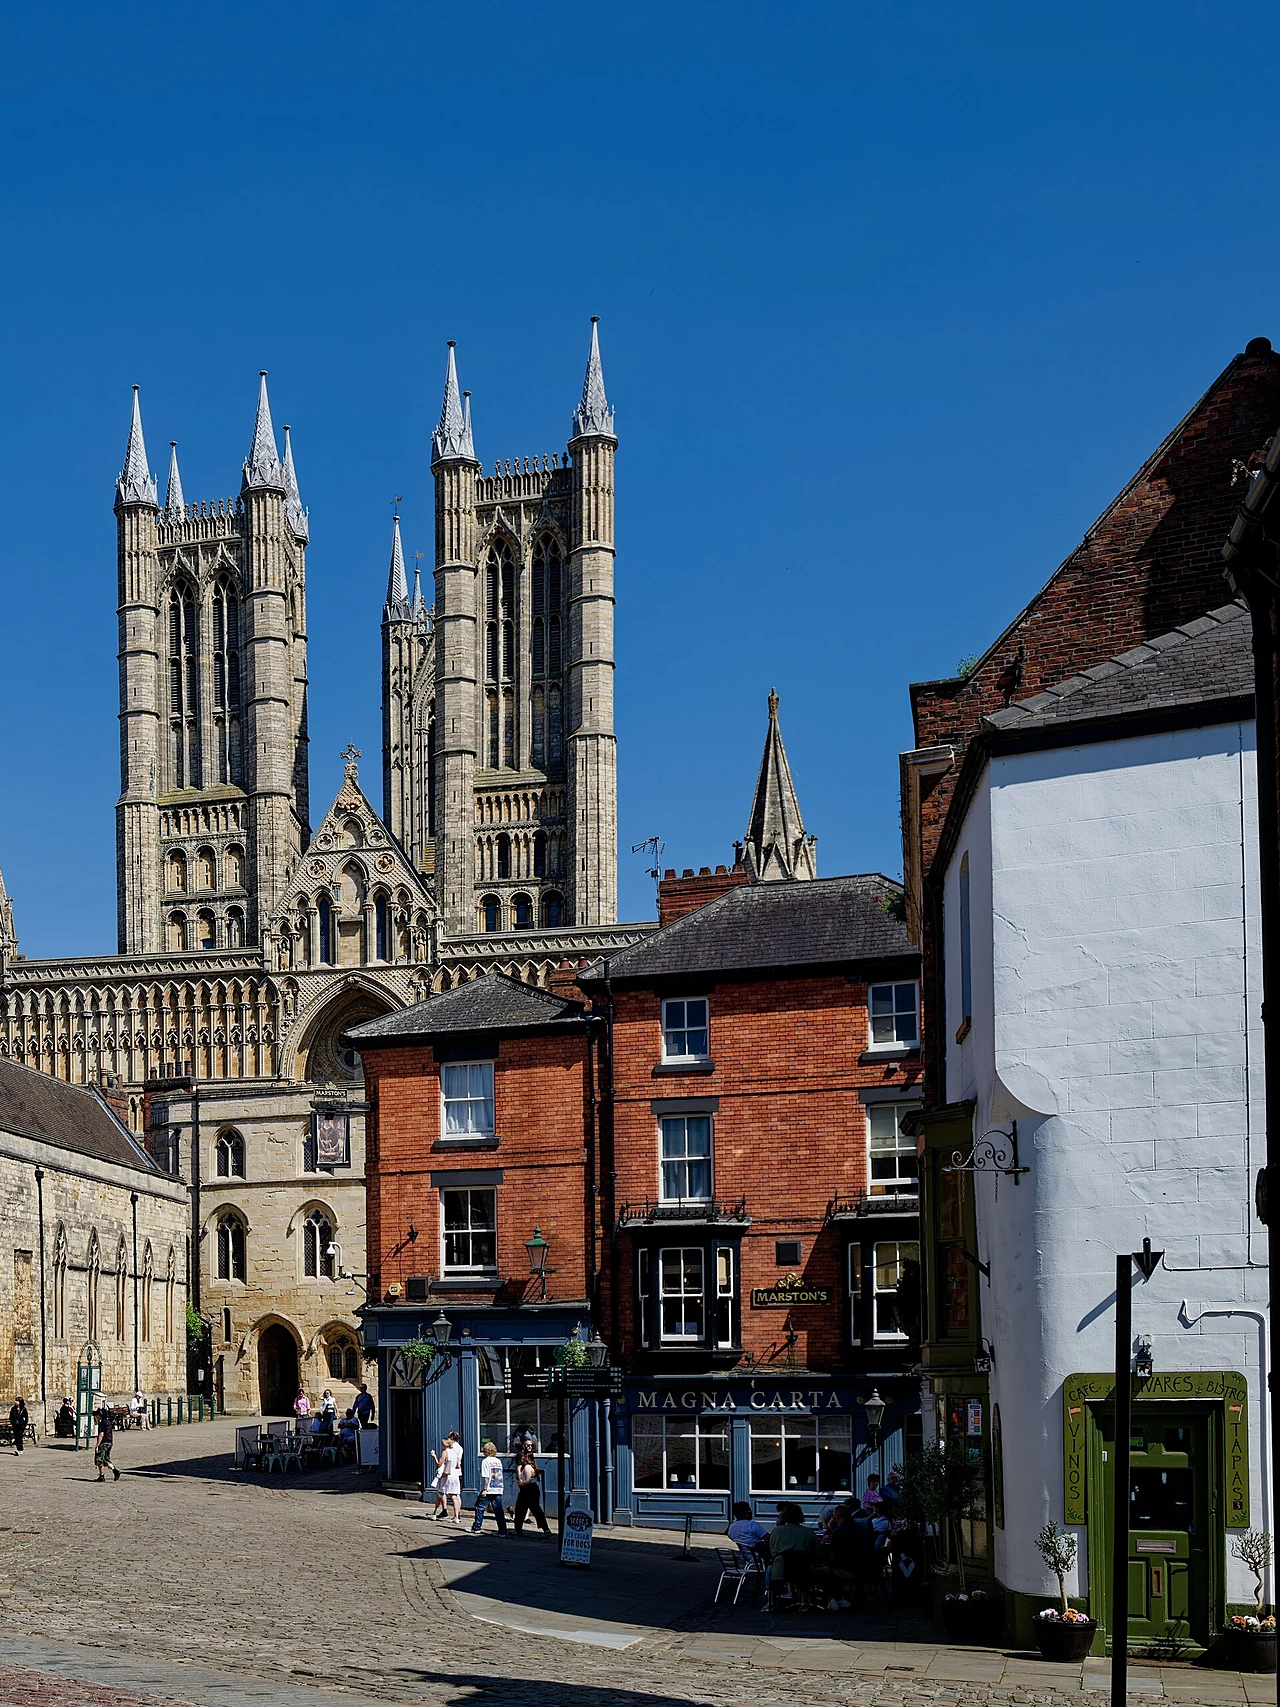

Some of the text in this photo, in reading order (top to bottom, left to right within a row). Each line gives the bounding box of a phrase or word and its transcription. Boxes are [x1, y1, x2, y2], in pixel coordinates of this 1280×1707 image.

[756, 1291, 828, 1302] MARSTON'S
[637, 1391, 843, 1409] MAGNA CARTA
[1130, 1376, 1194, 1394] LIVARES
[1206, 1380, 1247, 1402] BISTRO
[1067, 1423, 1081, 1500] VINOS
[1230, 1422, 1244, 1501] TAPAS
[563, 1538, 575, 1547] FOR
[575, 1540, 591, 1550] DOGS
